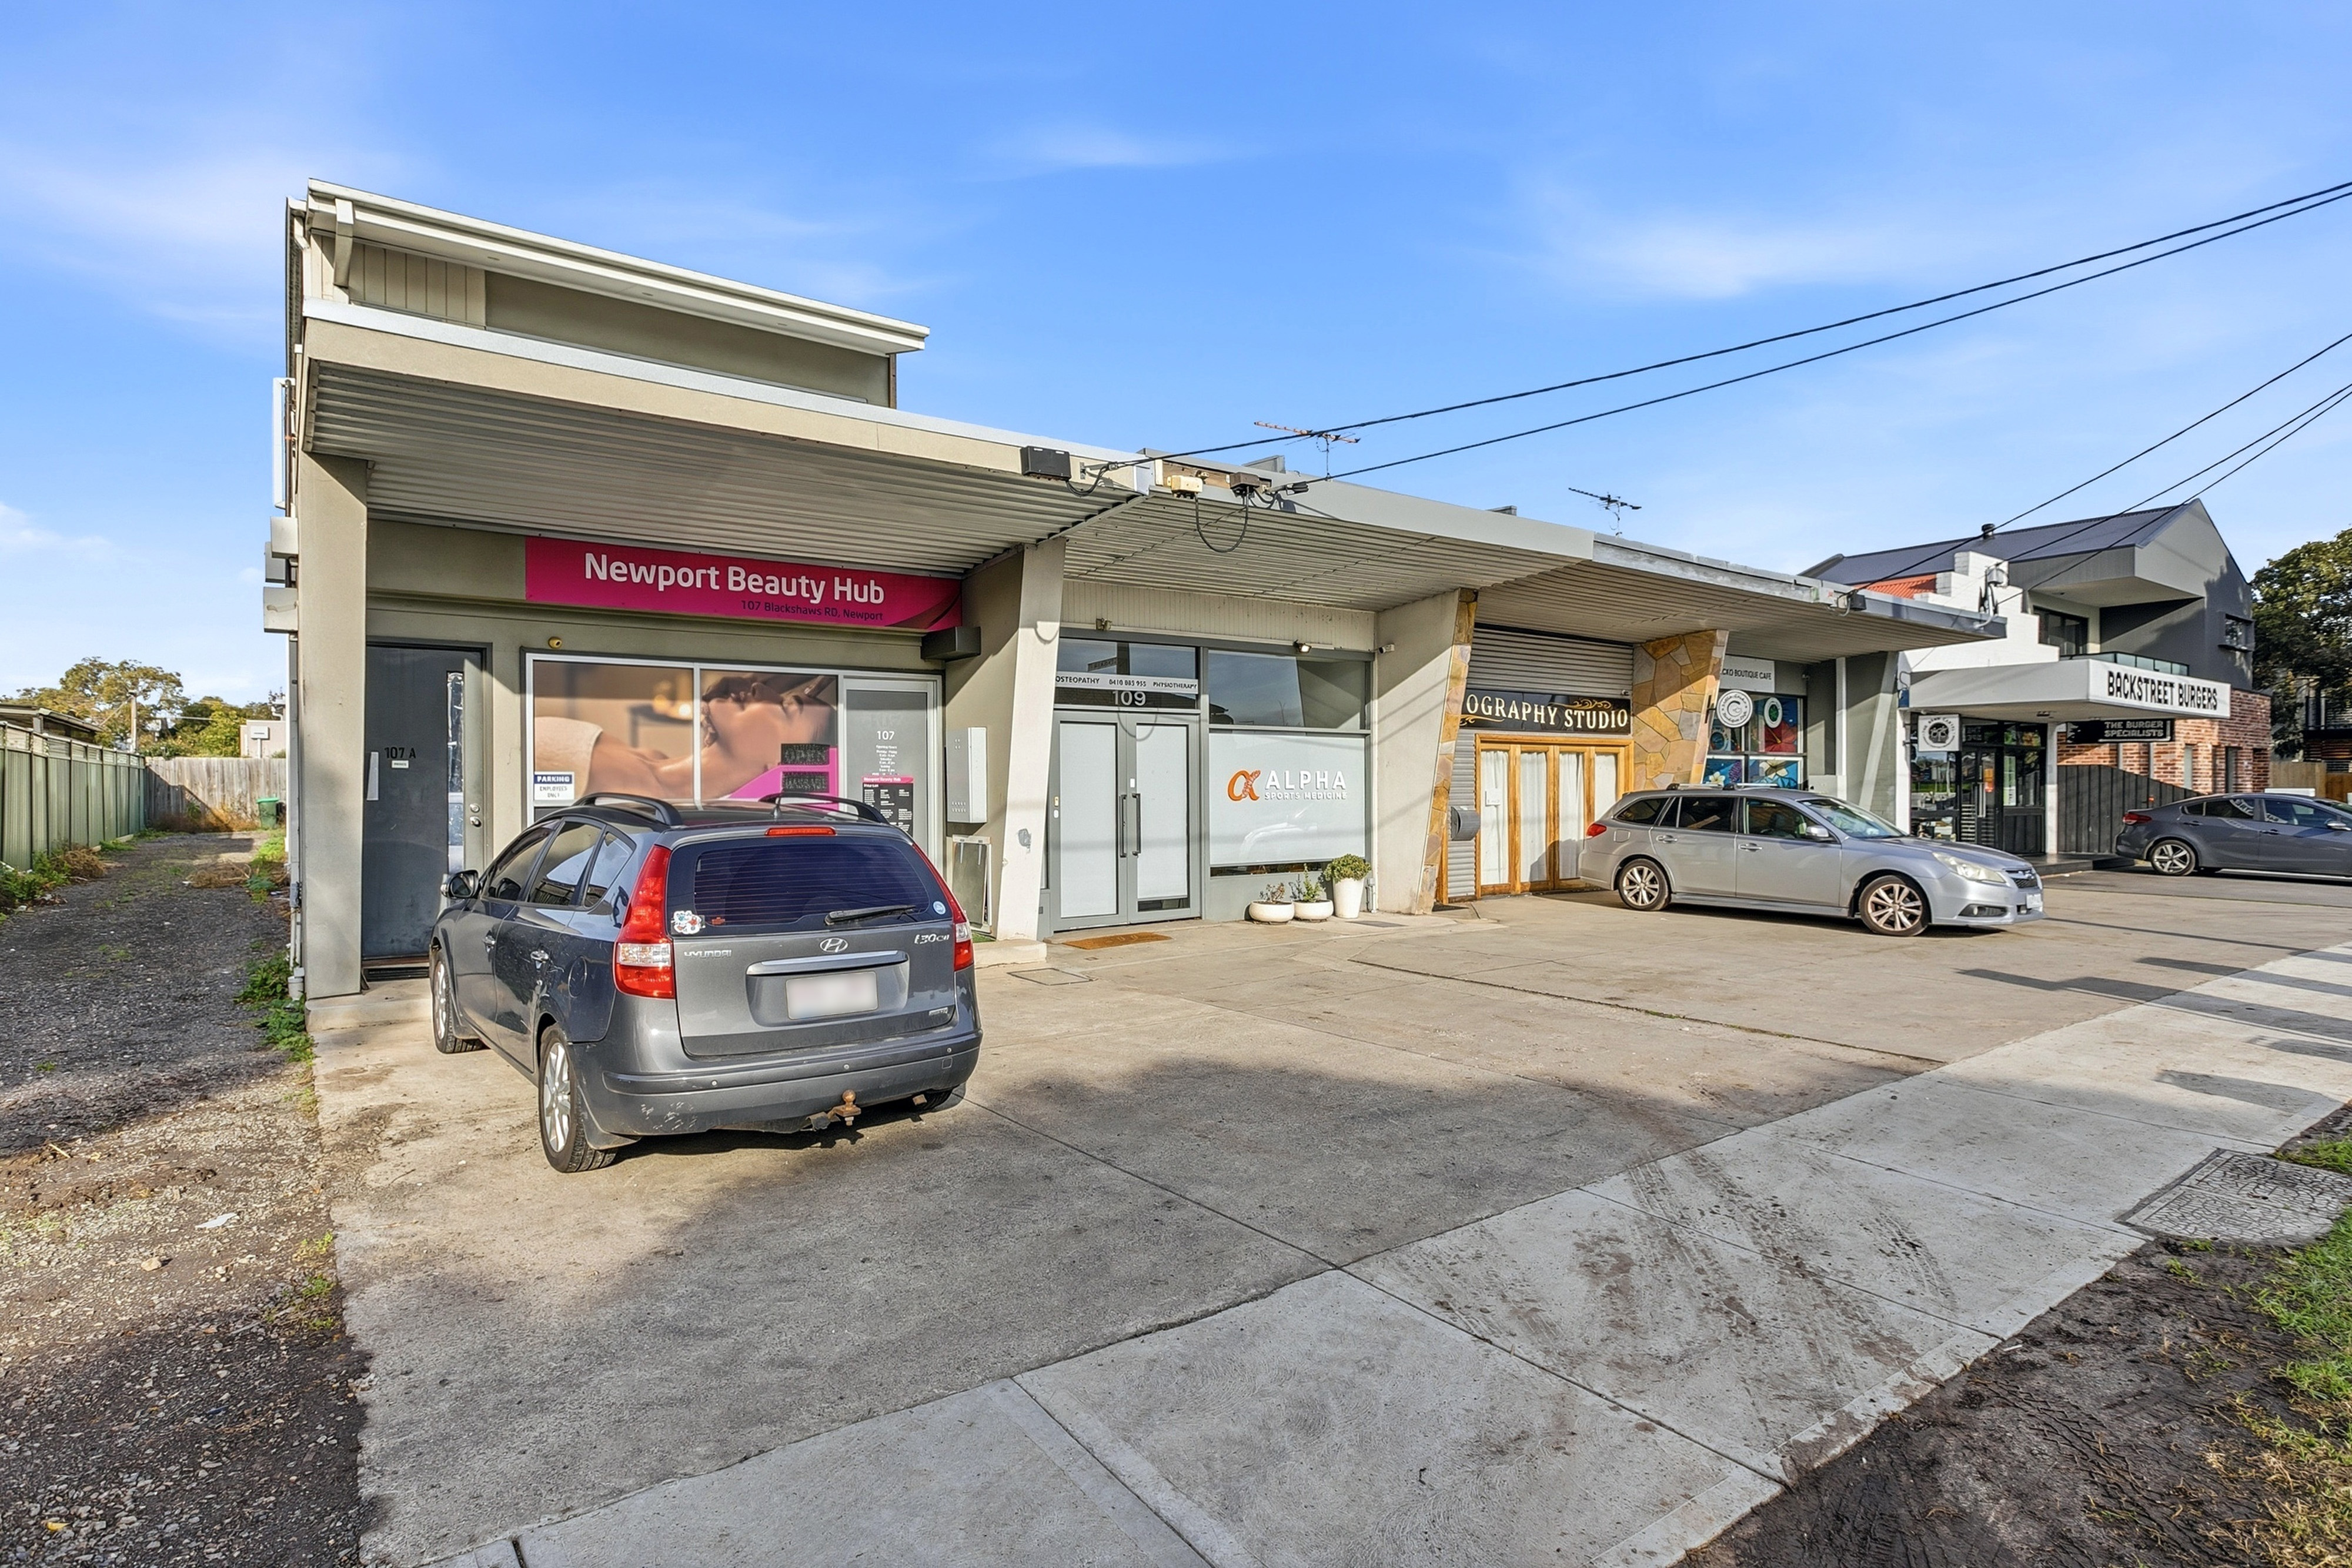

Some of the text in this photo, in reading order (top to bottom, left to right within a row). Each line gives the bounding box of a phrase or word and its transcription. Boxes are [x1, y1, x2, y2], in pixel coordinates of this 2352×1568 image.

[584, 553, 884, 604] Newport Beauty Hub
[741, 600, 883, 620] 107 Blackshaws RD, Newport
[1055, 676, 1100, 684] OSTEOPATHY
[1734, 670, 1758, 679] BOUTIQUE
[2107, 670, 2217, 710] BACKSTREET BURGERS
[1112, 690, 1146, 706] 109
[1466, 694, 1628, 729] OGRAPHY STUDIO
[2126, 721, 2164, 729] BURGER
[877, 731, 895, 740] 107
[2104, 729, 2164, 737] SPECIALISTS
[384, 747, 416, 758] 107 A
[1265, 770, 1347, 790] ALPHA
[1265, 791, 1347, 800] SPORTS MEDICINE
